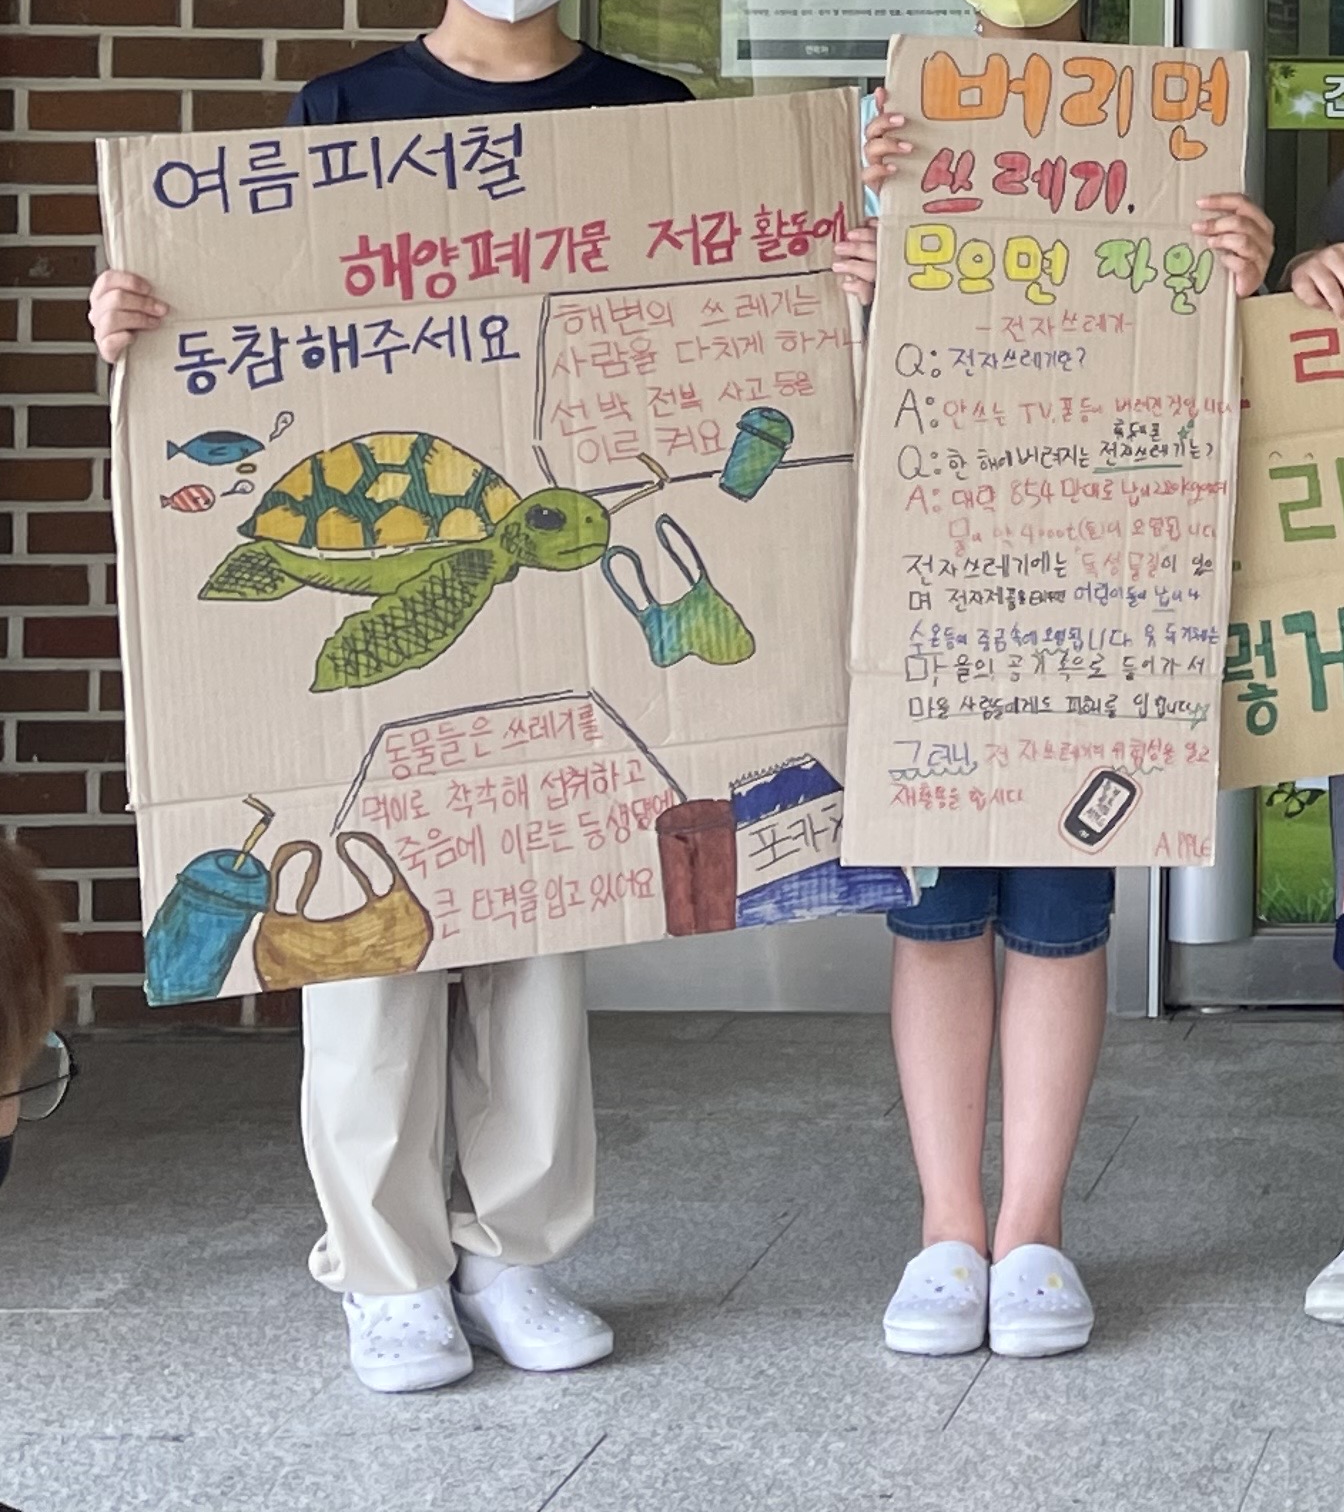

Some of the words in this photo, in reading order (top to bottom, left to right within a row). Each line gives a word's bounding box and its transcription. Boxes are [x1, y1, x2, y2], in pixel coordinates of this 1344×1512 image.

[920, 50, 1230, 161] 버리면
[340, 220, 611, 300] 해양폐기물
[647, 213, 741, 266] 저감
[903, 224, 1069, 305] 모으면
[1094, 237, 1213, 315] 자원
[553, 297, 674, 336] 해변의
[701, 286, 820, 327] 쓰레기는
[551, 338, 658, 380] 사람을
[676, 331, 764, 365] 다치게
[551, 392, 633, 437] 선박
[718, 378, 769, 402] 사고
[385, 716, 493, 780] 동물들은
[502, 704, 601, 750] 쓰레기를
[446, 777, 529, 819] 착각해
[397, 824, 485, 879] 죽음에
[501, 820, 573, 864] 이르는
[434, 888, 461, 939] 큰
